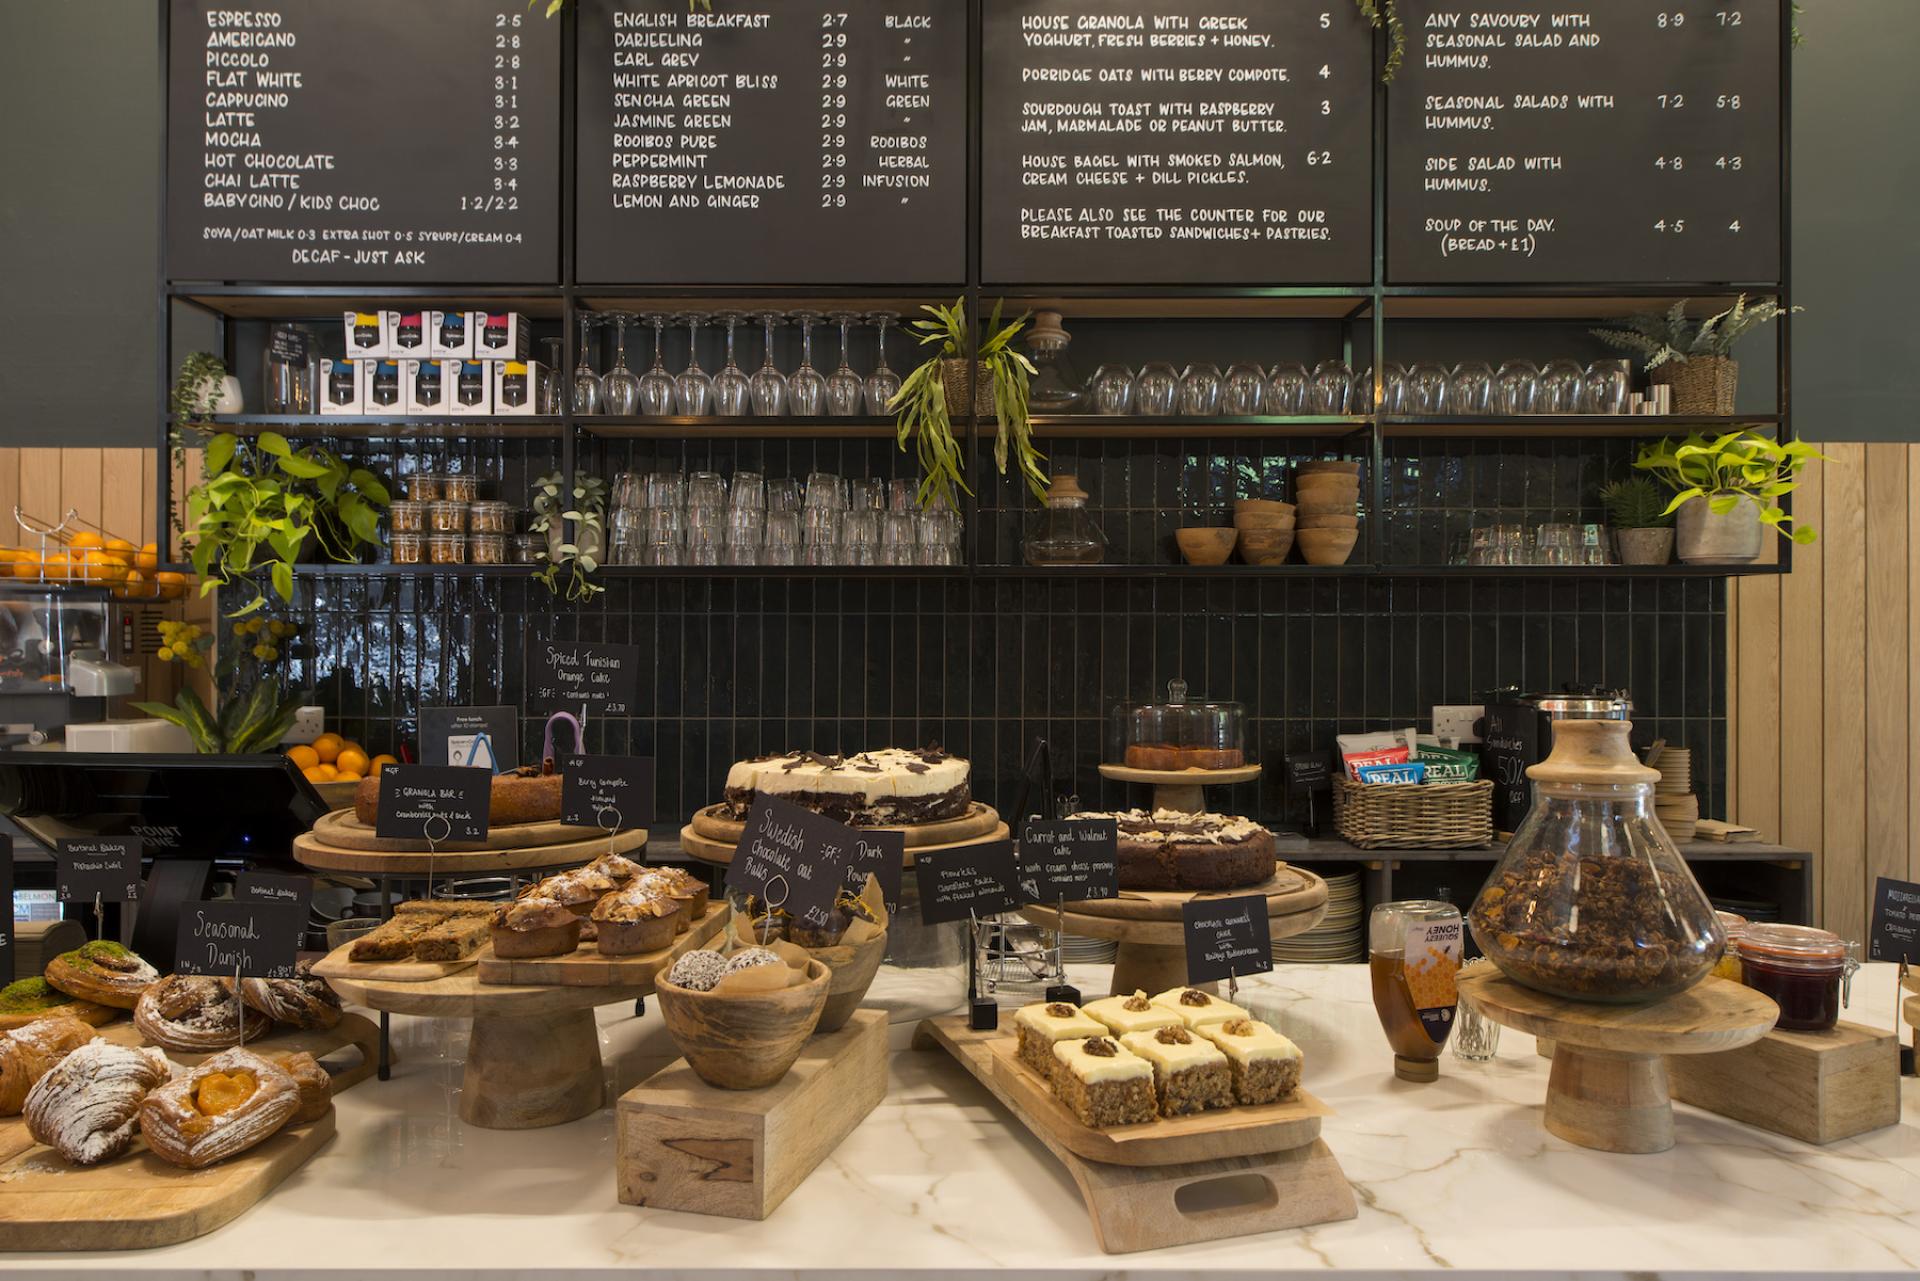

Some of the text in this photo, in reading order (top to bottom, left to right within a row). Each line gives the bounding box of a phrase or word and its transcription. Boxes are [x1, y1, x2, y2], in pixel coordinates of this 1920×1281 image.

[206, 10, 282, 28] ESPRESSO
[614, 12, 771, 28] ENGLISH BREAKFAST
[885, 15, 931, 29] BLACK
[1022, 15, 1248, 30] HOUSE GRANOLA WITH GREEK
[1320, 13, 1330, 29] 5
[1424, 13, 1590, 28] ANY SAVOURY WITH
[206, 31, 296, 48] AMERICANO
[614, 32, 702, 48] DARJEELING
[1023, 32, 1275, 48] YOGHURT, FRESH BERRIES HONEY.
[1426, 33, 1600, 48] SEASONAL SALAD AND
[206, 50, 269, 67] PICCOLO
[614, 52, 700, 67] EARL GREY
[1426, 54, 1491, 69] HUMMUS.
[206, 70, 302, 88] FLAT WHITE
[1022, 68, 1290, 82] PORRIDGE OATS WITH BERRY COMPOTE.
[1318, 64, 1331, 79] 4
[613, 72, 778, 89] WHITE APRICOT BLISS
[885, 74, 929, 88] WHITE
[205, 92, 289, 108] CAPPUCINO
[614, 92, 730, 108] SENCHA GREEN
[886, 94, 930, 108] GREEN
[1321, 100, 1331, 115] 3
[1425, 94, 1614, 110] SEASONAL SALADS WITH
[1022, 102, 1275, 116] SOURDOUGH TOAST WITH RASPBERRY
[206, 111, 255, 128] LATTE
[614, 113, 731, 128] JASMINE GREEN
[1021, 119, 1287, 135] JAM, MARMALADE OR PEANUT BUTTER.
[1425, 115, 1494, 130] HUMMUS.
[205, 131, 262, 147] MOCHA
[614, 133, 717, 149] ROOIBOS PURE
[870, 135, 927, 149] ROOIBOS
[204, 152, 335, 170] HOT CHOCOLATE
[612, 153, 708, 168] PEPPERMINT
[879, 156, 930, 168] HERBAL
[1022, 152, 1285, 170] HOUSE BAGEL WITH SMOKED SALMON,
[1425, 156, 1562, 172] SIDE SALAD WITH
[204, 173, 300, 190] CHAI LATTE
[612, 173, 785, 190] RASPBERRY LEMONADE
[863, 174, 930, 188] INFUSION
[1022, 170, 1249, 186] CREAM CHEESE DILL PICKLES.
[1424, 178, 1491, 192] HUMMUS.
[339, 196, 380, 211] CHOC
[613, 193, 760, 208] LEMON AND GINGER
[1021, 208, 1325, 223] PLEASE ALSO SEE THE COUNTER FOR OUR
[1021, 224, 1101, 239] BREAKFAST
[1105, 226, 1163, 239] TOASTED
[1266, 227, 1331, 241] PASTRIES.
[1425, 218, 1555, 233] SOUP OF THE DAY.
[267, 228, 295, 240] MILK
[322, 229, 359, 240] EXTRA
[362, 230, 391, 241] SHOT
[1441, 233, 1535, 257] (BREAD £1)
[292, 248, 425, 264] DECAF JUST ASK
[546, 646, 620, 669] Spiced Tunisian
[558, 669, 585, 690] Orange
[1371, 771, 1414, 784] REAL
[1424, 764, 1465, 778] REAL
[1497, 755, 1524, 785] 50%
[403, 787, 456, 799] GRANOLA BAR
[131, 826, 183, 837] POINT
[759, 808, 805, 853] Swedish
[1025, 826, 1055, 844] Carrot
[142, 837, 182, 847] ONE
[856, 840, 883, 861] Dark
[744, 856, 769, 882] Balls
[194, 910, 260, 939] Seasonal
[1426, 924, 1460, 935] HONEY
[1425, 933, 1459, 943] SQUEEZY
[207, 942, 252, 968] Danish
